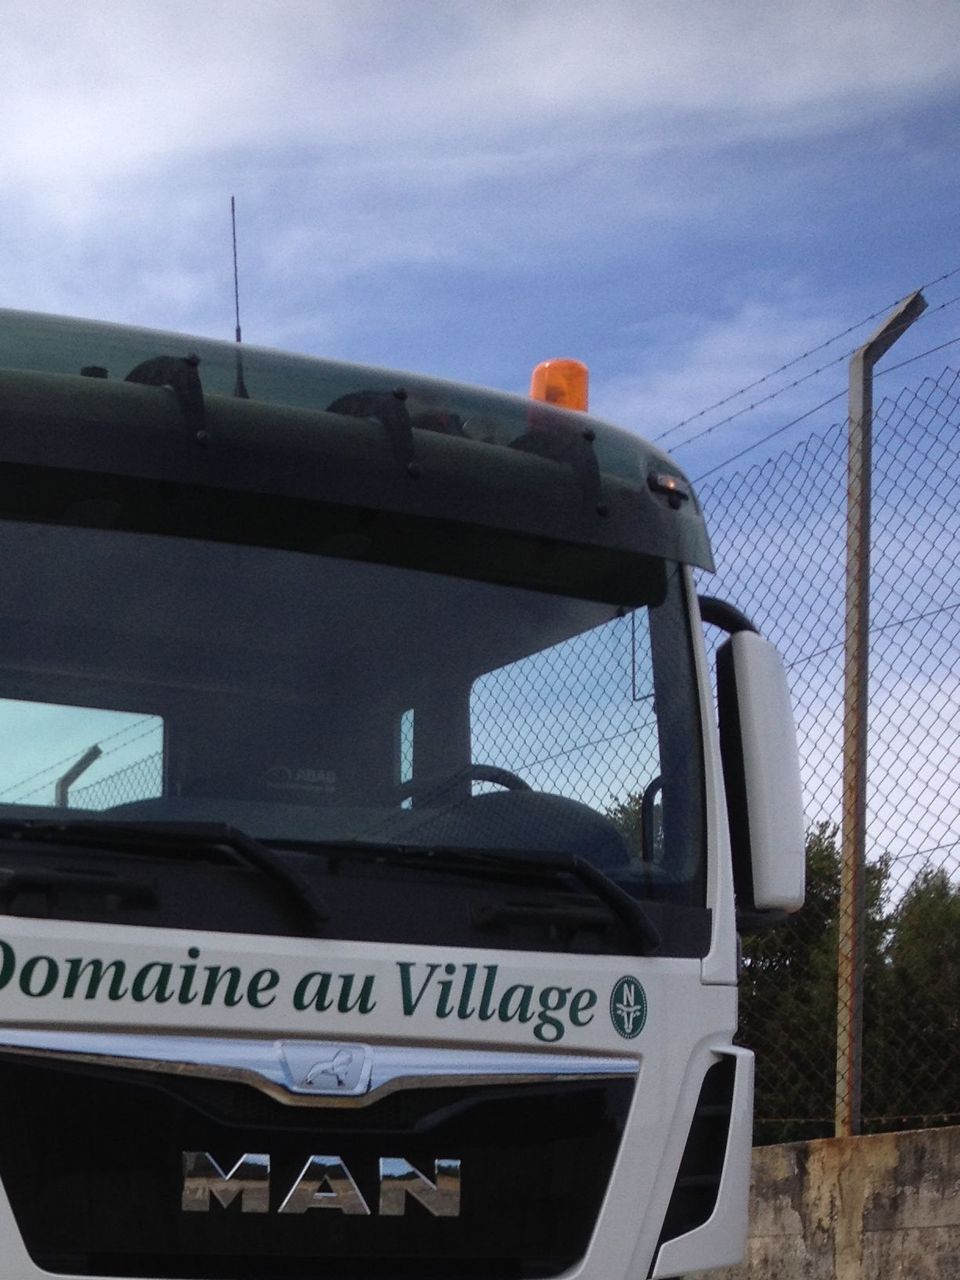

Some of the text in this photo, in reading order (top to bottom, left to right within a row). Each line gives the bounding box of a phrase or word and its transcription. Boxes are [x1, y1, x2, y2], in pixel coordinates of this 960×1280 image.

[292, 971, 377, 1015] au
[395, 961, 598, 1043] Village
[182, 1151, 461, 1216] MAN
